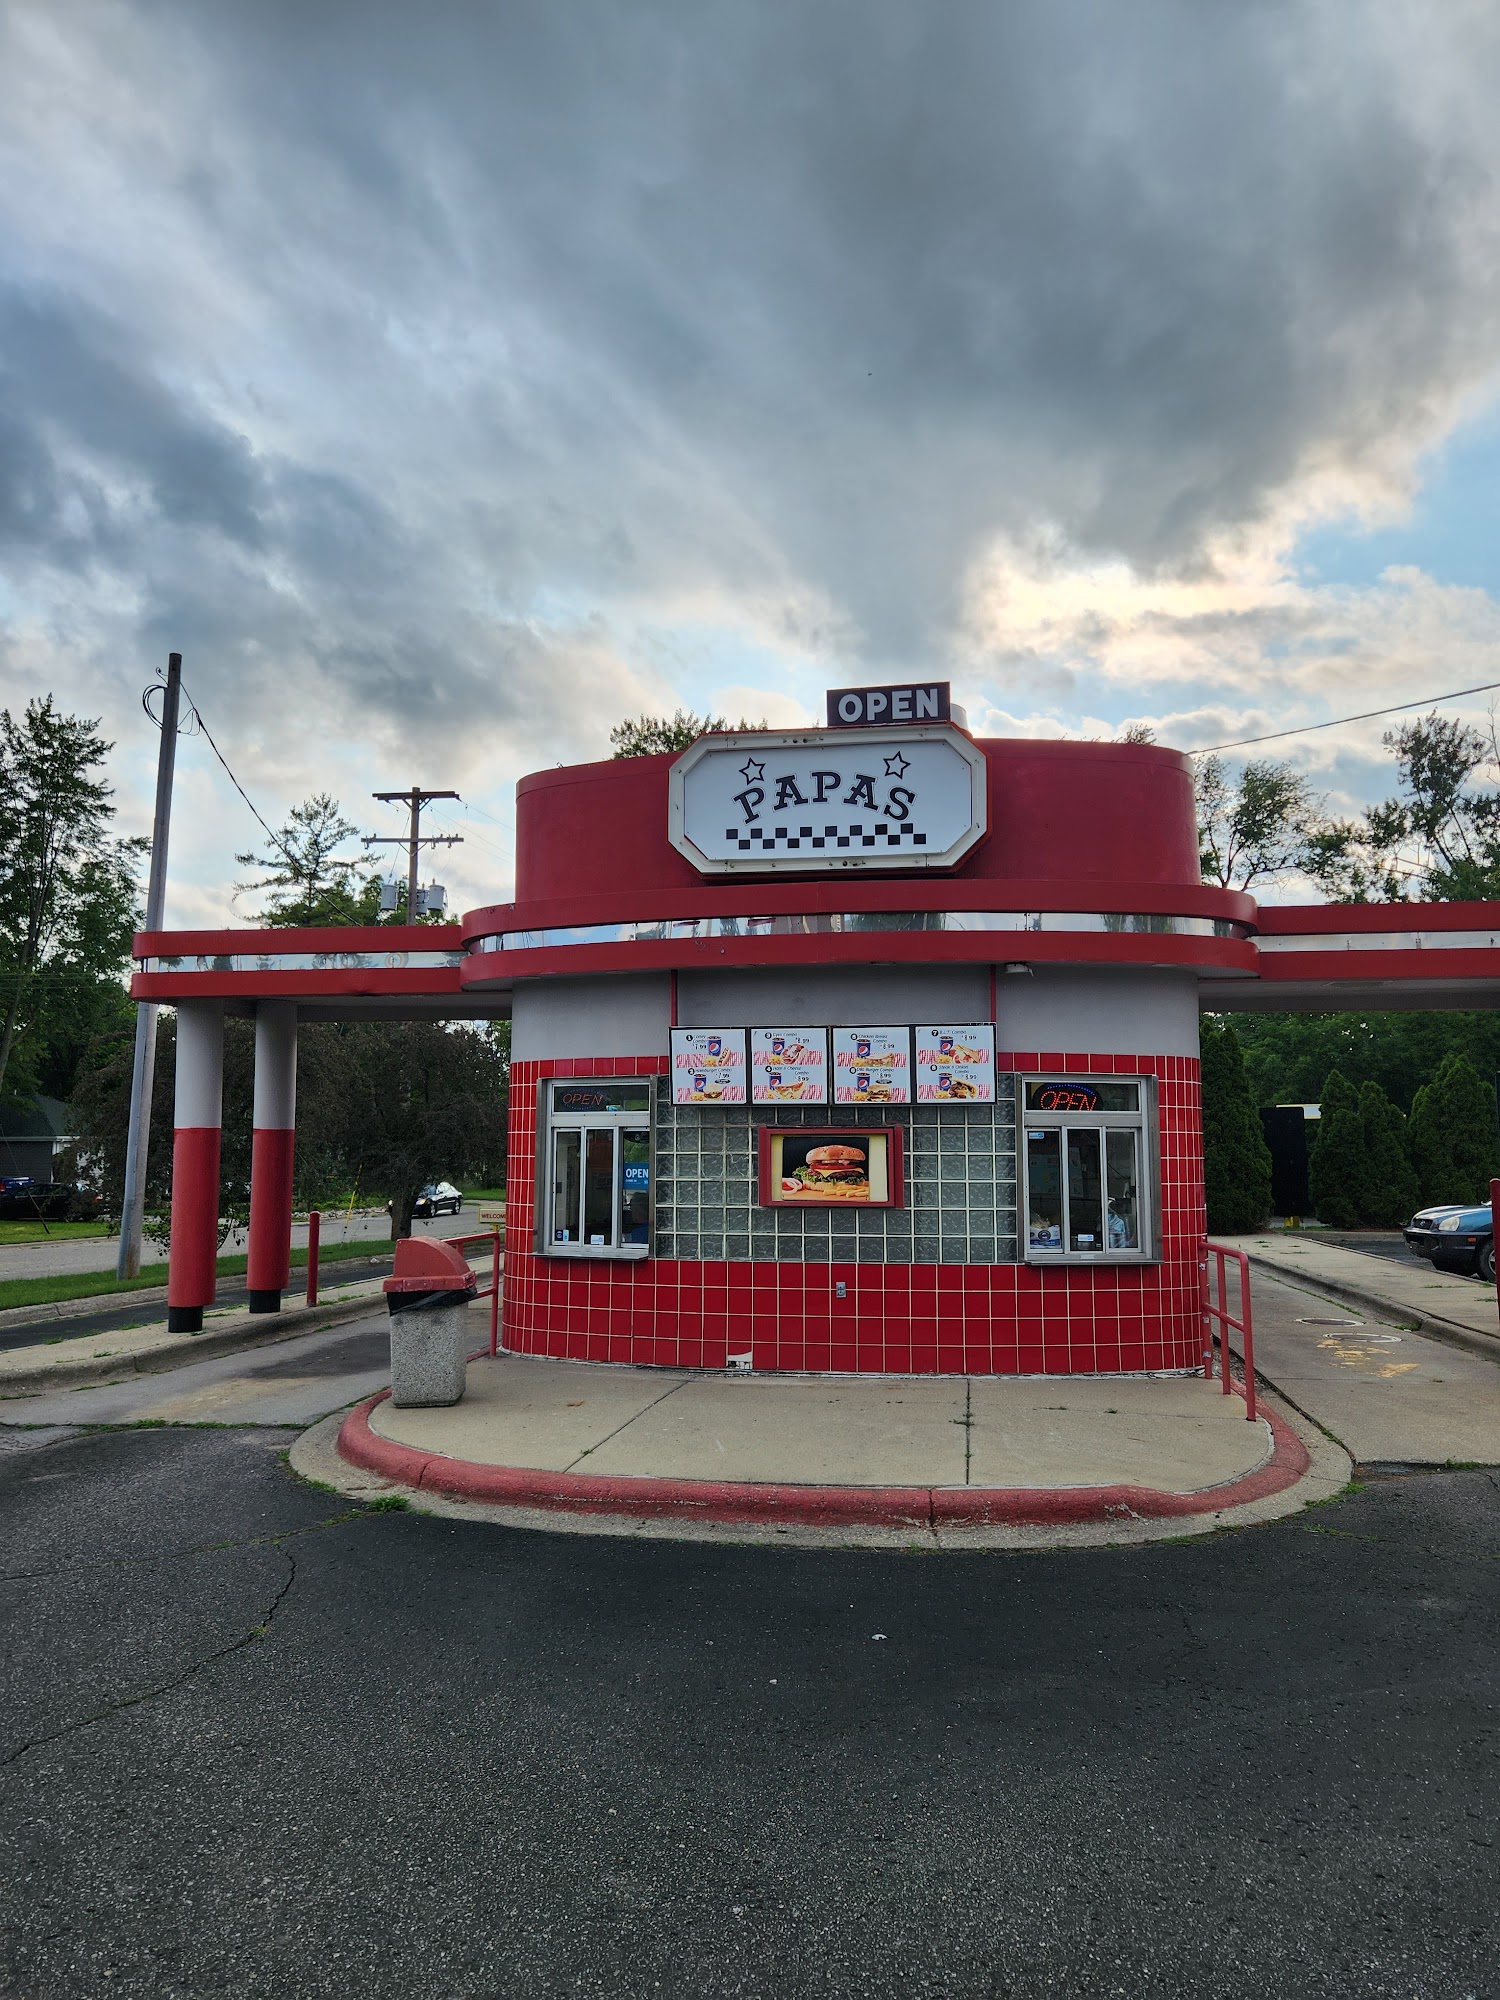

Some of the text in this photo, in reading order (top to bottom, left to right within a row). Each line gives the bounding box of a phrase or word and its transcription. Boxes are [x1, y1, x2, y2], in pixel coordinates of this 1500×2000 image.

[838, 688, 938, 722] OPEN
[733, 770, 917, 825] PAPAS
[562, 1093, 603, 1106] OPEN
[1040, 1090, 1097, 1111] OPEN
[625, 1168, 649, 1178] OPEN
